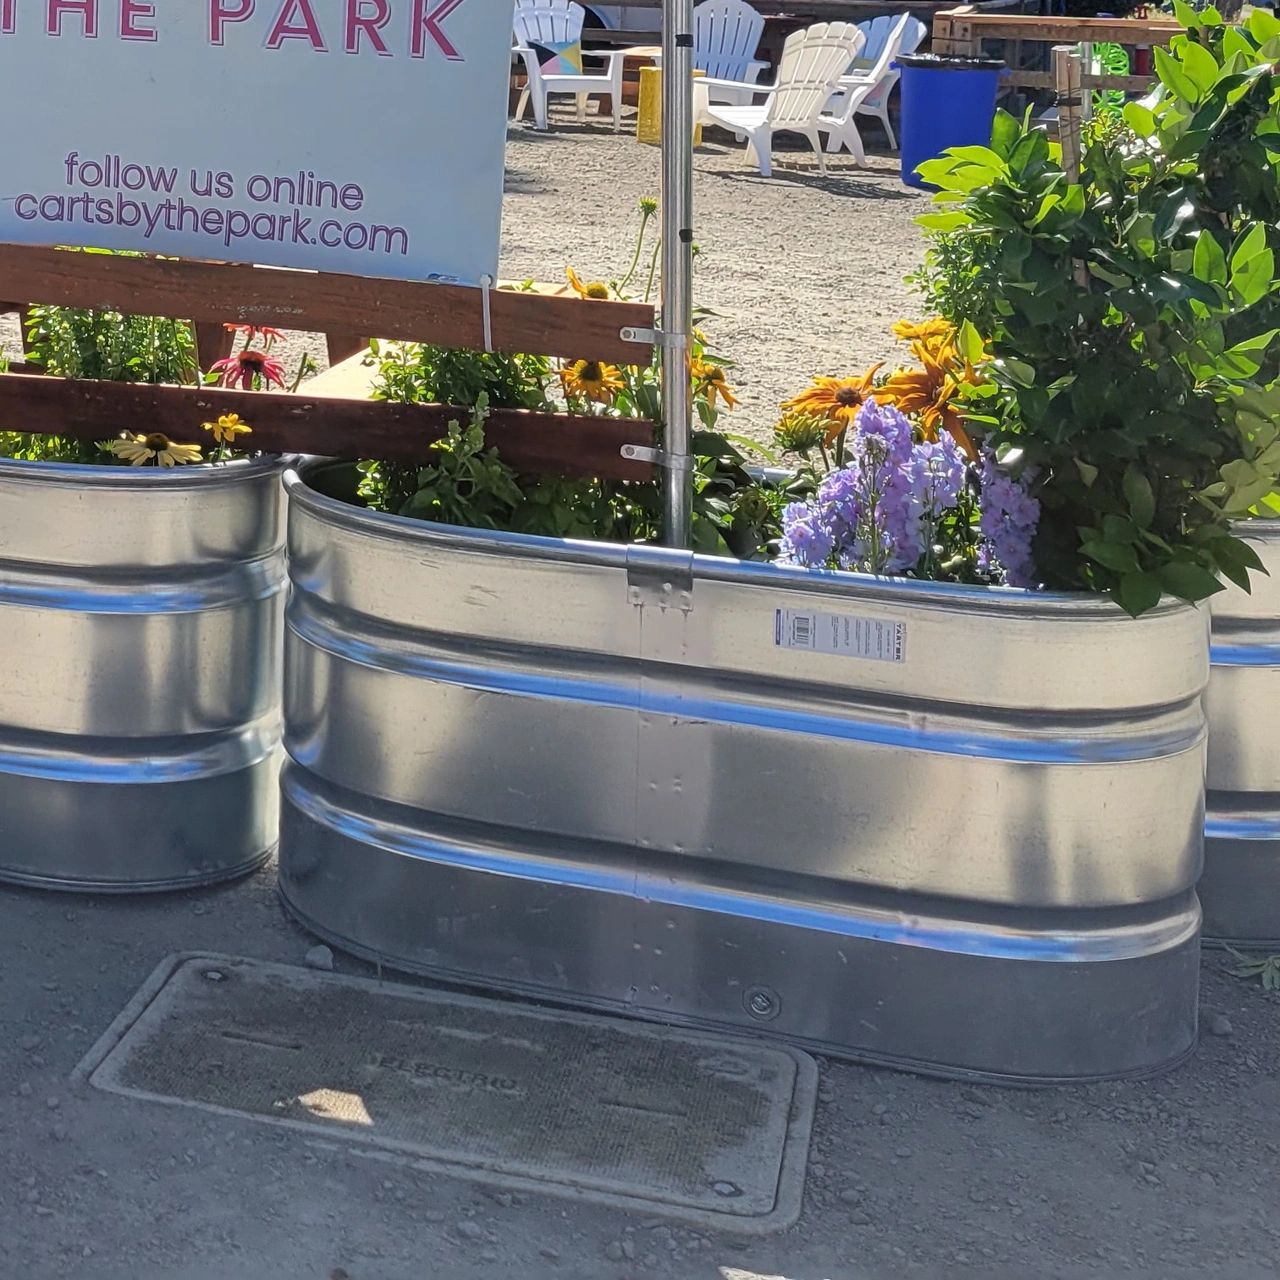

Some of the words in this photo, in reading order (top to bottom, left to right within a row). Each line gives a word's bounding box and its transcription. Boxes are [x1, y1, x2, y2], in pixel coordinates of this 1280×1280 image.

[64, 151, 178, 193] follow
[190, 169, 234, 199] us
[247, 171, 364, 211] online
[14, 191, 409, 256] cartsbythepark.com
